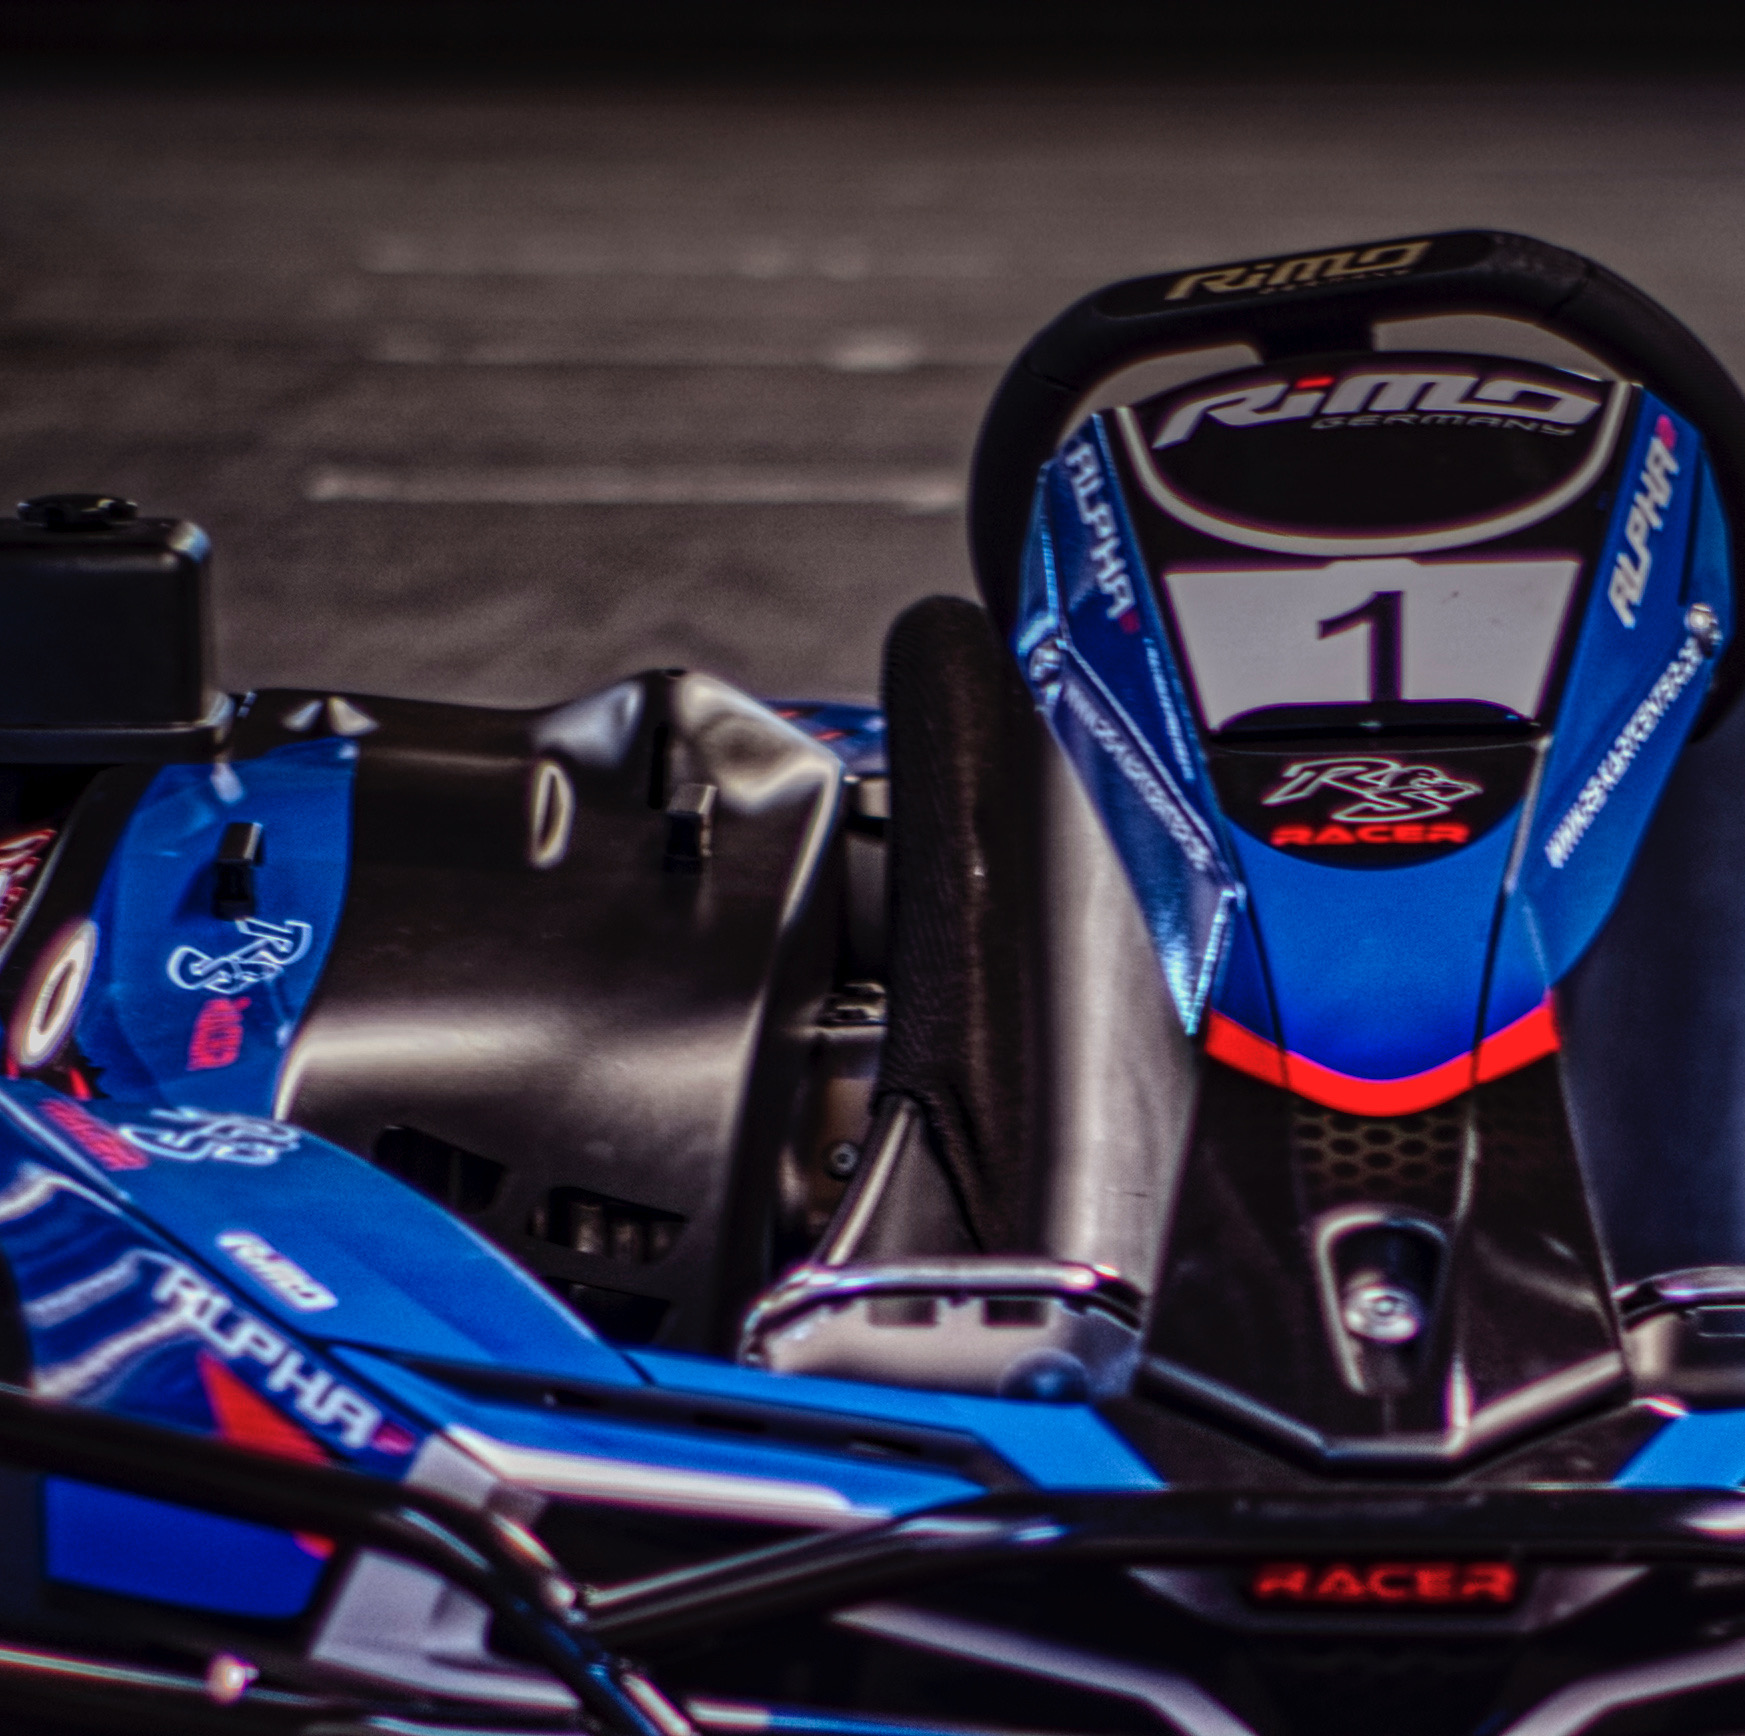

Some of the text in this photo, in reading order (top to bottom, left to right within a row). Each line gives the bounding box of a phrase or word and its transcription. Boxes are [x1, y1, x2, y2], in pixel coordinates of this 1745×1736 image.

[1310, 413, 1576, 436] GERMANY
[1317, 590, 1404, 702] 1
[1270, 823, 1469, 847] RACER
[1255, 1562, 1517, 1600] RACER
